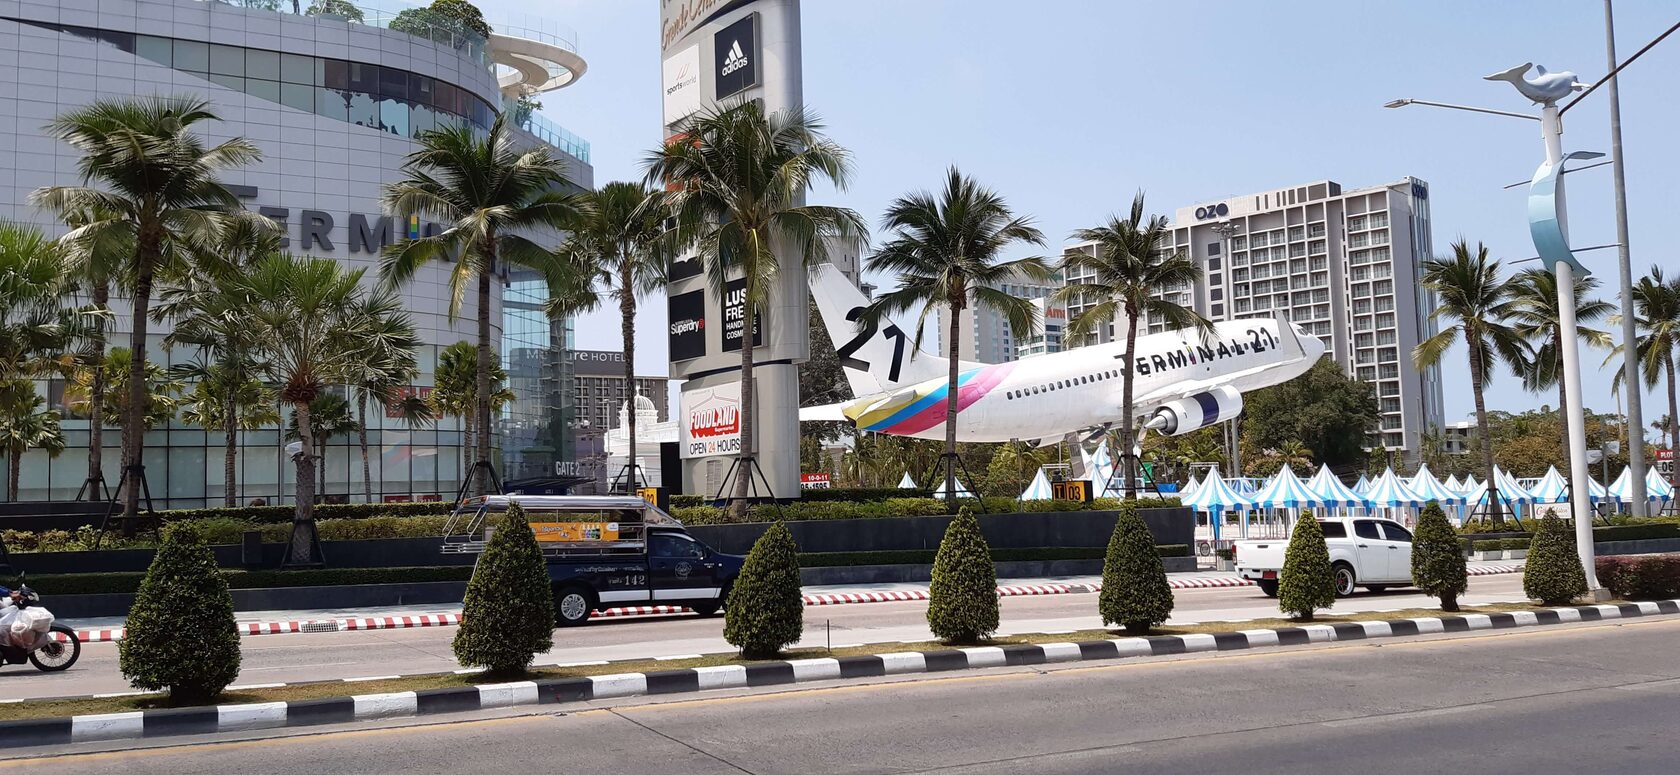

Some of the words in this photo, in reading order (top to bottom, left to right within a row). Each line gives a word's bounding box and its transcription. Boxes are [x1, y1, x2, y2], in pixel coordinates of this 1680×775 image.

[722, 56, 748, 77] adidas
[1195, 203, 1229, 220] OZO
[726, 288, 750, 307] LUS
[670, 320, 699, 335] Superdry
[836, 306, 906, 383] 21
[1247, 327, 1277, 353] 21
[591, 352, 626, 362] HOTEL
[690, 406, 736, 430] FOODLAND
[690, 442, 707, 455] OPEN
[708, 442, 716, 454] 24
[718, 438, 741, 452] HOURS
[556, 461, 575, 475] GATE
[575, 463, 580, 475] 2
[1662, 461, 1674, 473] 06
[1068, 485, 1081, 501] 03
[625, 574, 645, 586] 142
